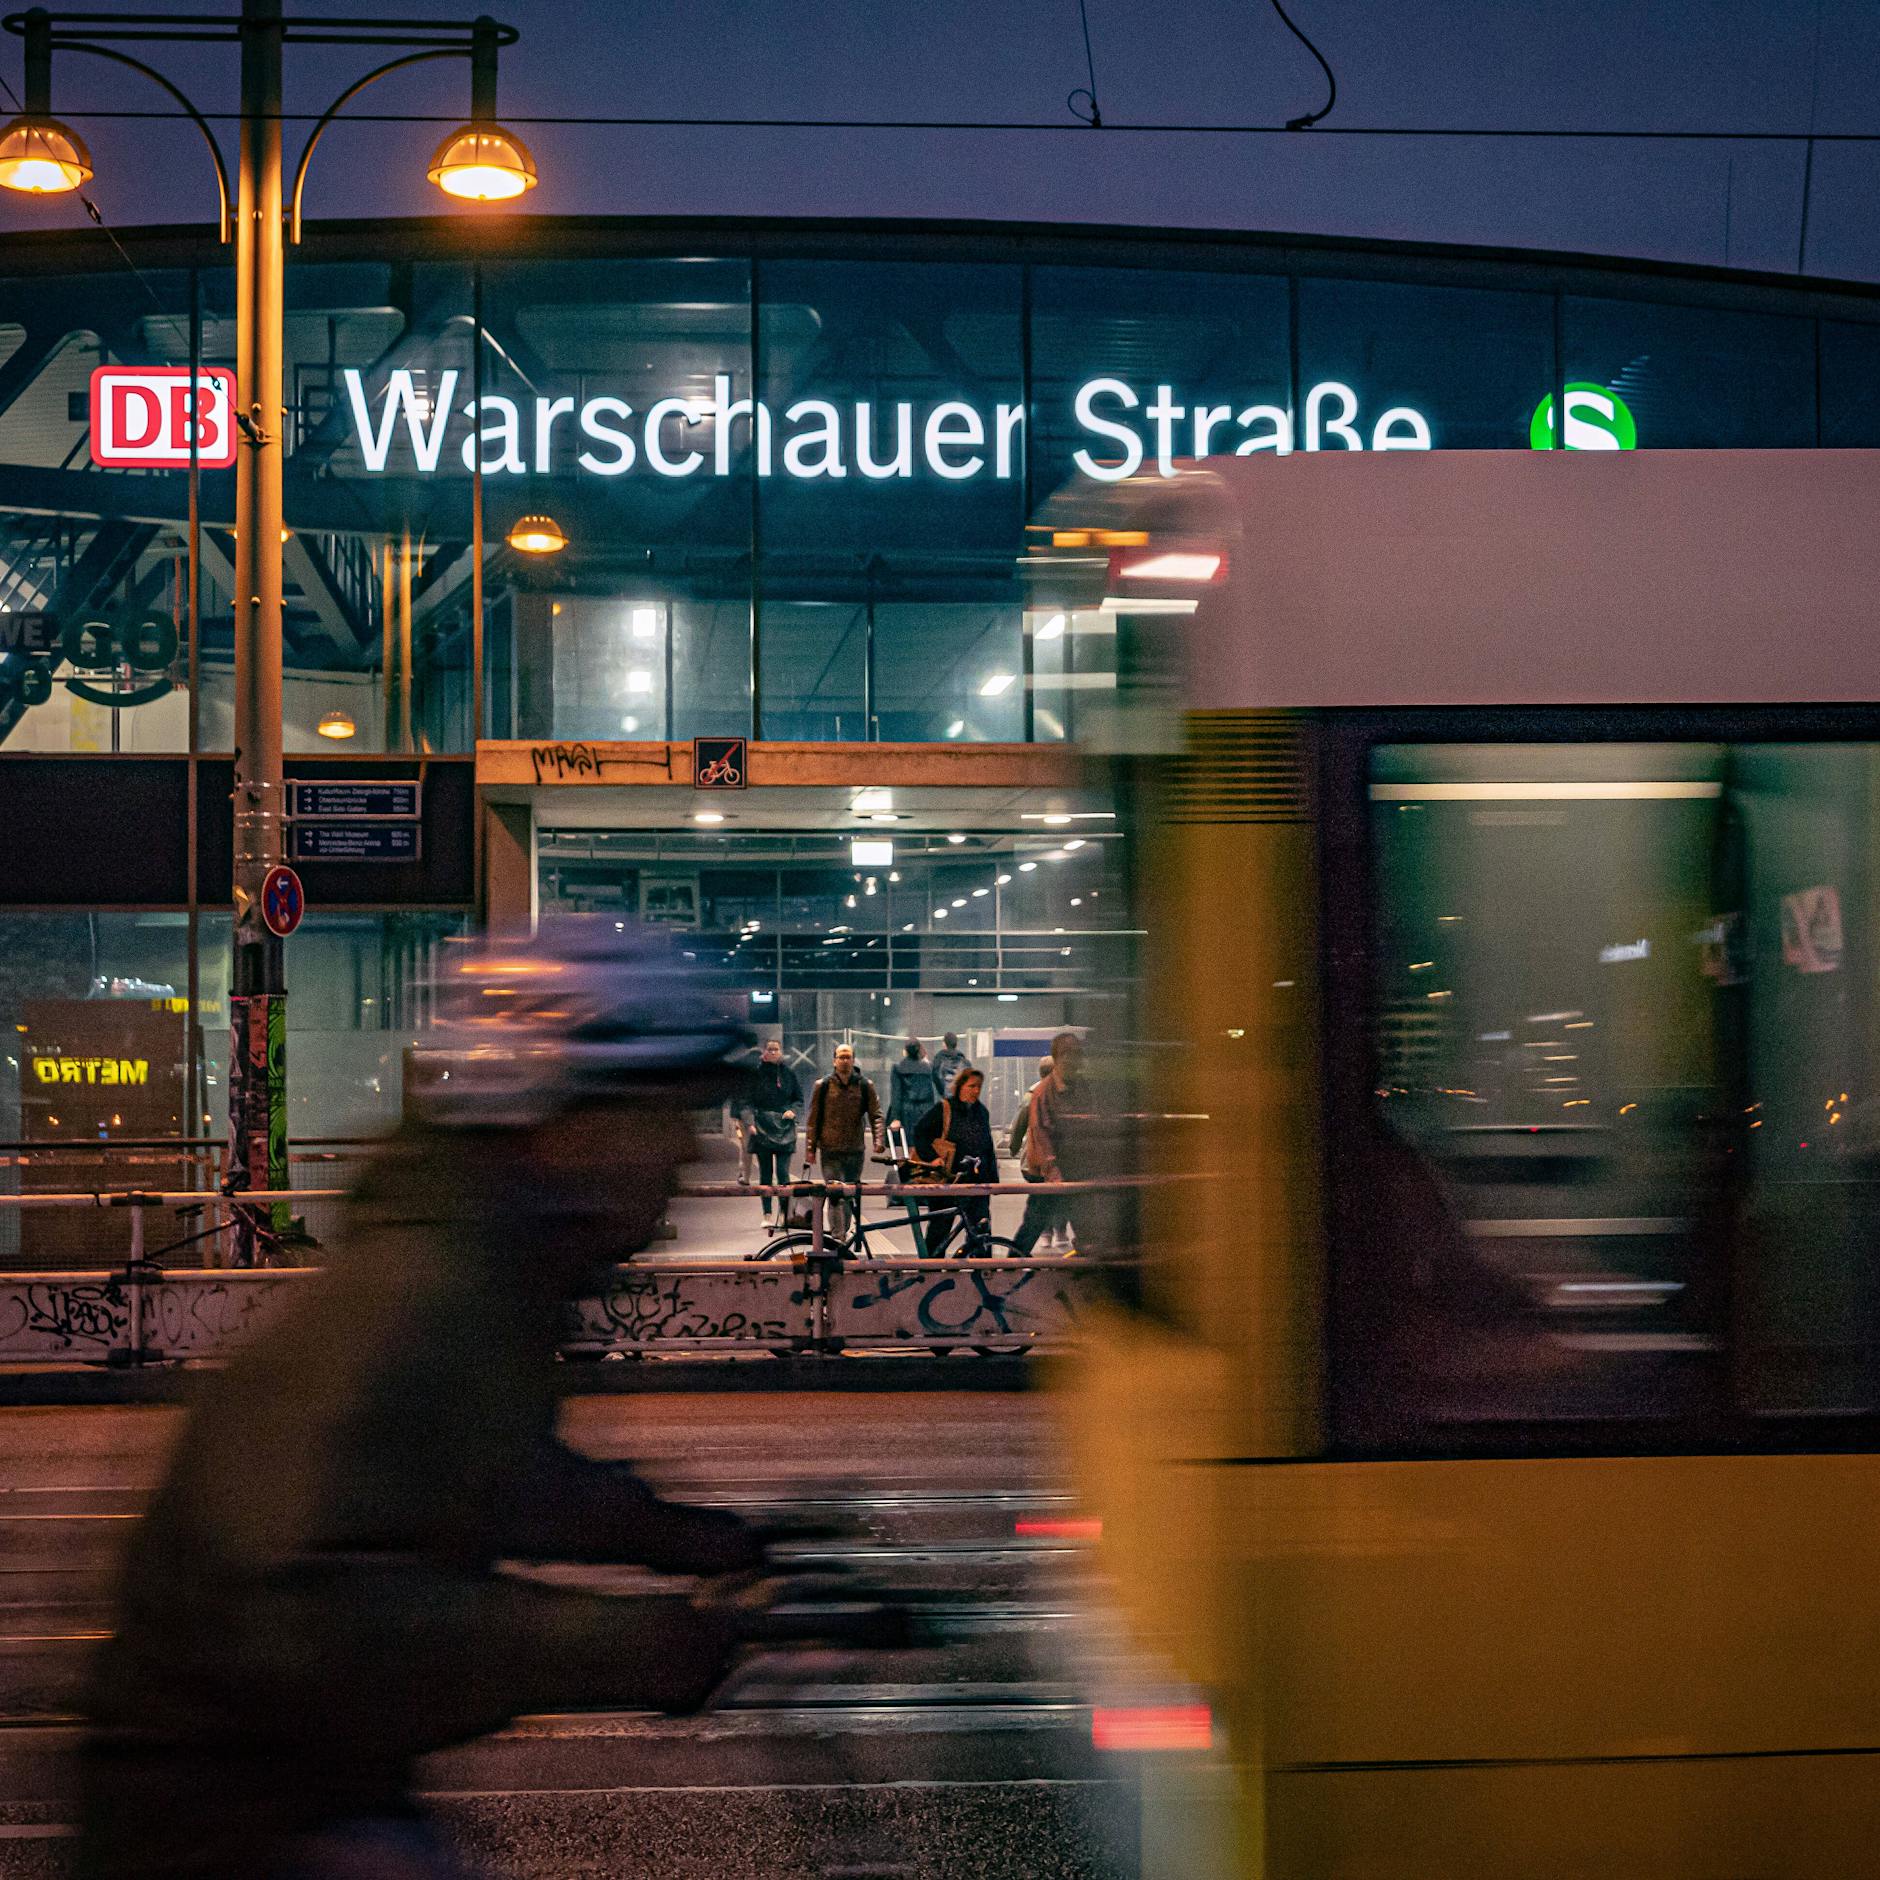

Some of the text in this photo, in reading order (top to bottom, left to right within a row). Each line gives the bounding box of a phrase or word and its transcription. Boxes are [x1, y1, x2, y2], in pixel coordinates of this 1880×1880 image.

[111, 385, 219, 449] DB
[344, 368, 1432, 482] Warschauer Straße
